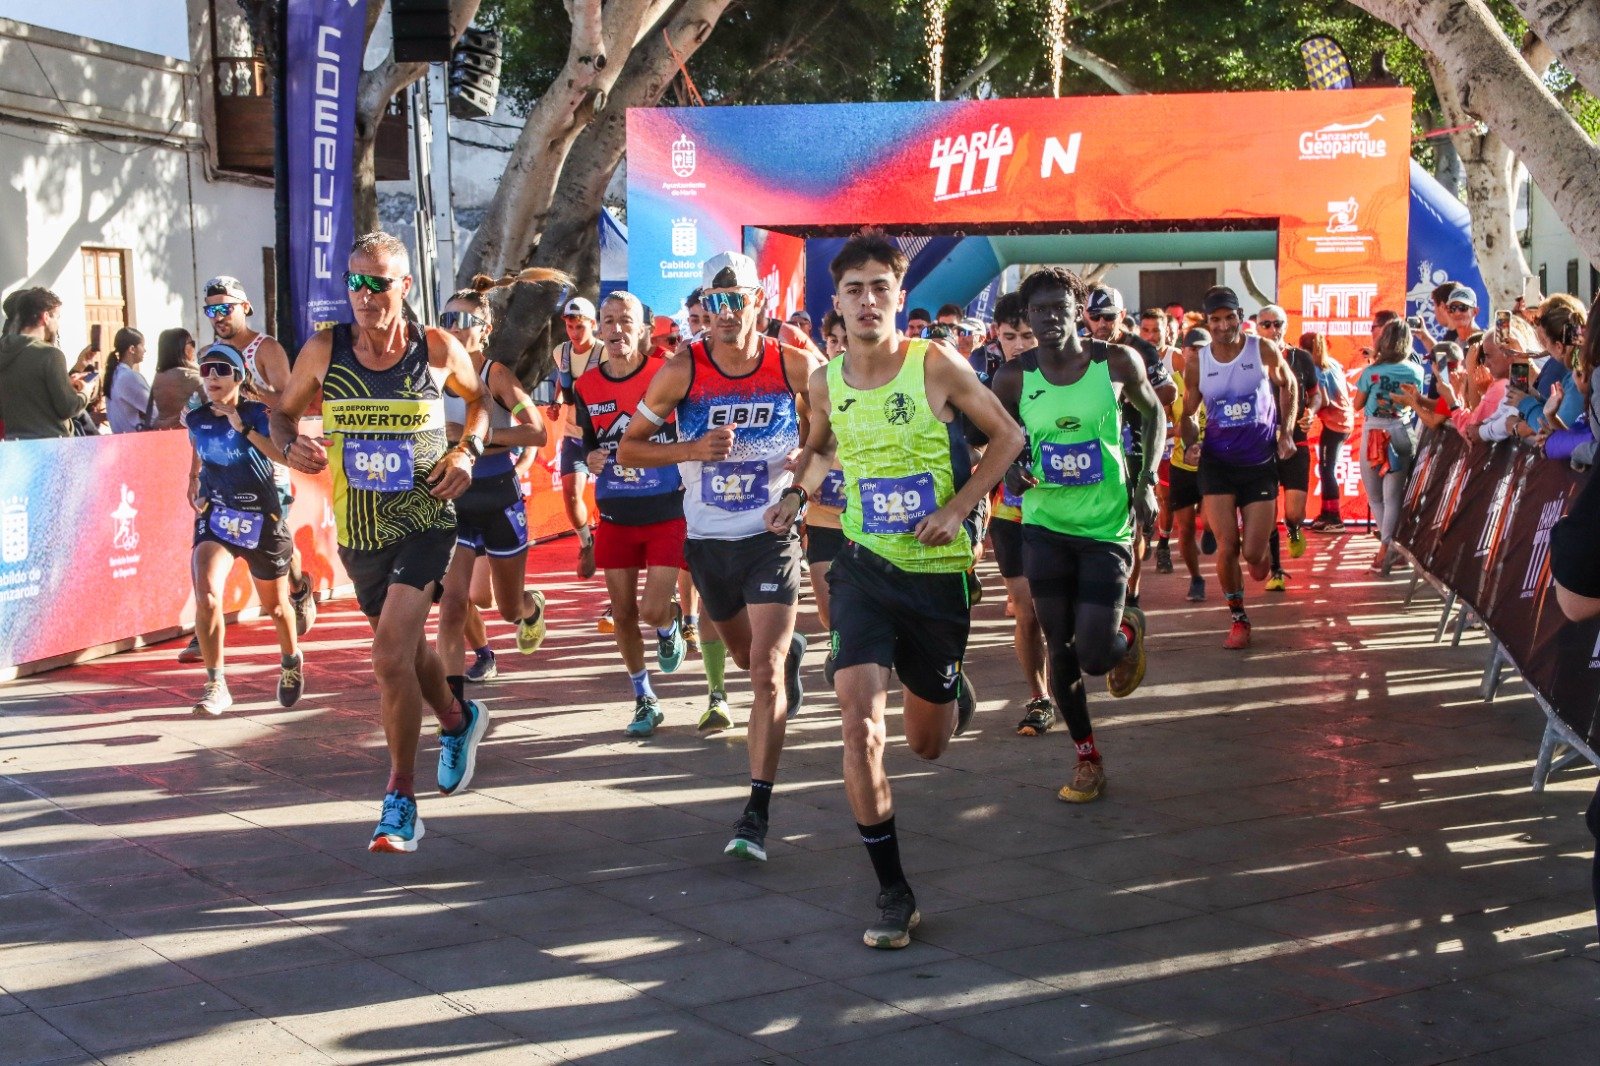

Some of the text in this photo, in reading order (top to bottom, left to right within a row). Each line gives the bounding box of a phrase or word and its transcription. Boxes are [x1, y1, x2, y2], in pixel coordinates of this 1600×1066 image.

[931, 123, 1014, 158] HARÍA
[1314, 129, 1369, 141] Lanzarote
[1299, 131, 1386, 159] Geoparque
[659, 260, 704, 270] Cabildo d
[661, 269, 704, 279] Lanzarot
[711, 406, 771, 427] EBR
[355, 451, 401, 473] 880
[1050, 452, 1091, 471] 680
[711, 473, 757, 493] 627
[872, 490, 921, 514] 829
[218, 515, 254, 534] 845
[29, 567, 42, 581] de
